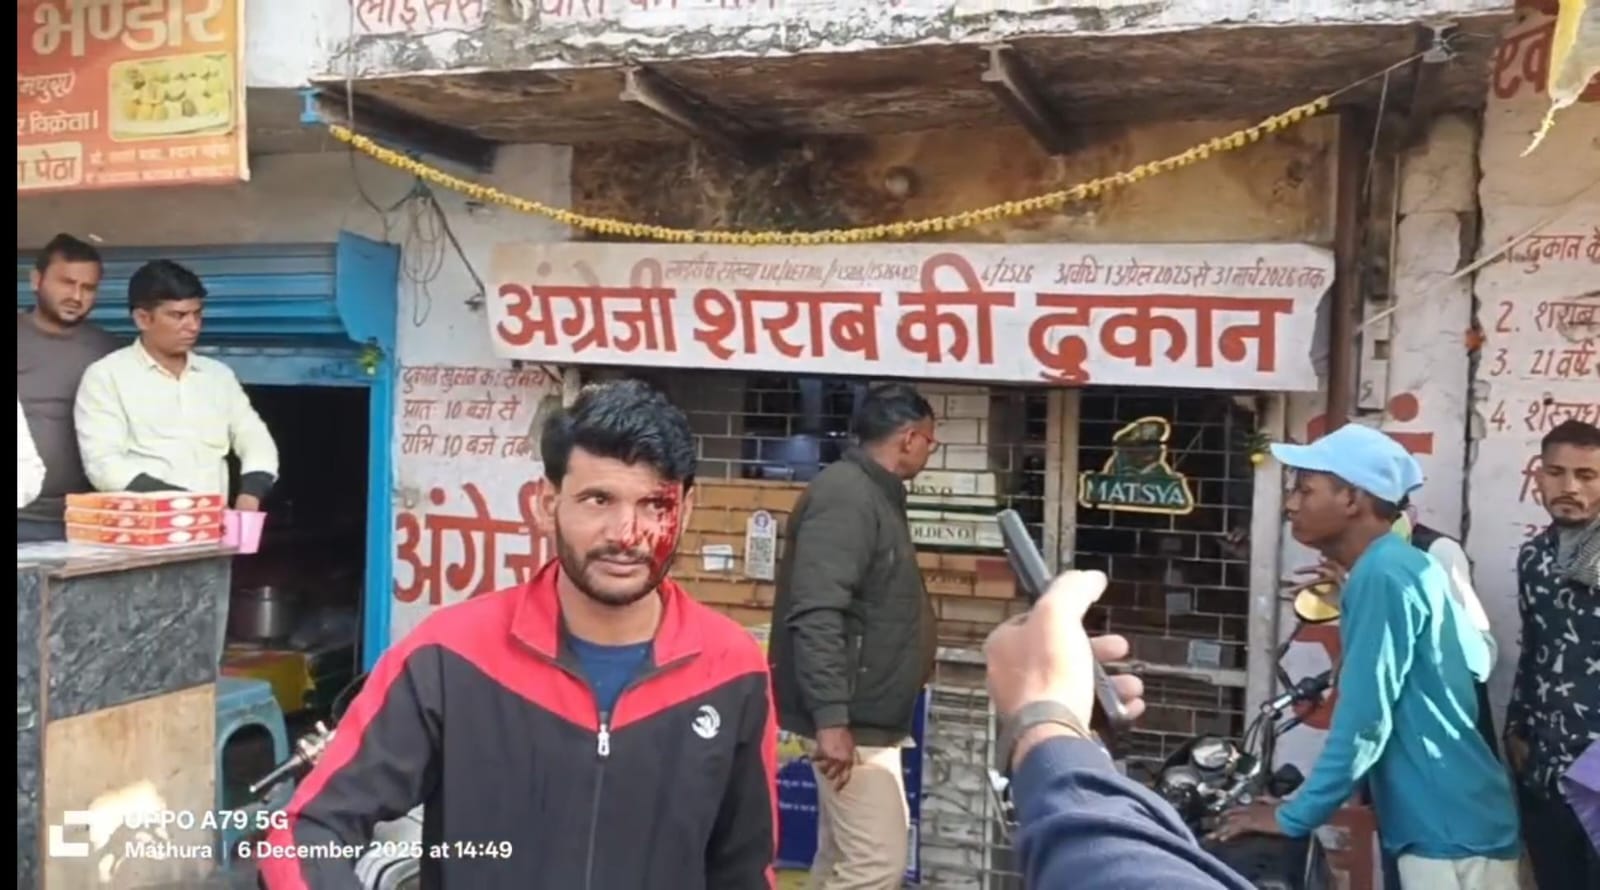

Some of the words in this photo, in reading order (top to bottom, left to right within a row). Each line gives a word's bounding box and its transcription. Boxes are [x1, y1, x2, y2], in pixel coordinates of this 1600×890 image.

[1525, 234, 1584, 274] दुकान
[692, 288, 882, 361] शराब
[896, 251, 1016, 365] की
[1027, 292, 1294, 385] दुकान
[1496, 302, 1520, 333] 2.
[1490, 348, 1512, 377] 3.
[444, 401, 463, 420] 10
[1490, 400, 1512, 432] 4.
[443, 434, 464, 458] 10
[1085, 480, 1186, 505] MATSYA
